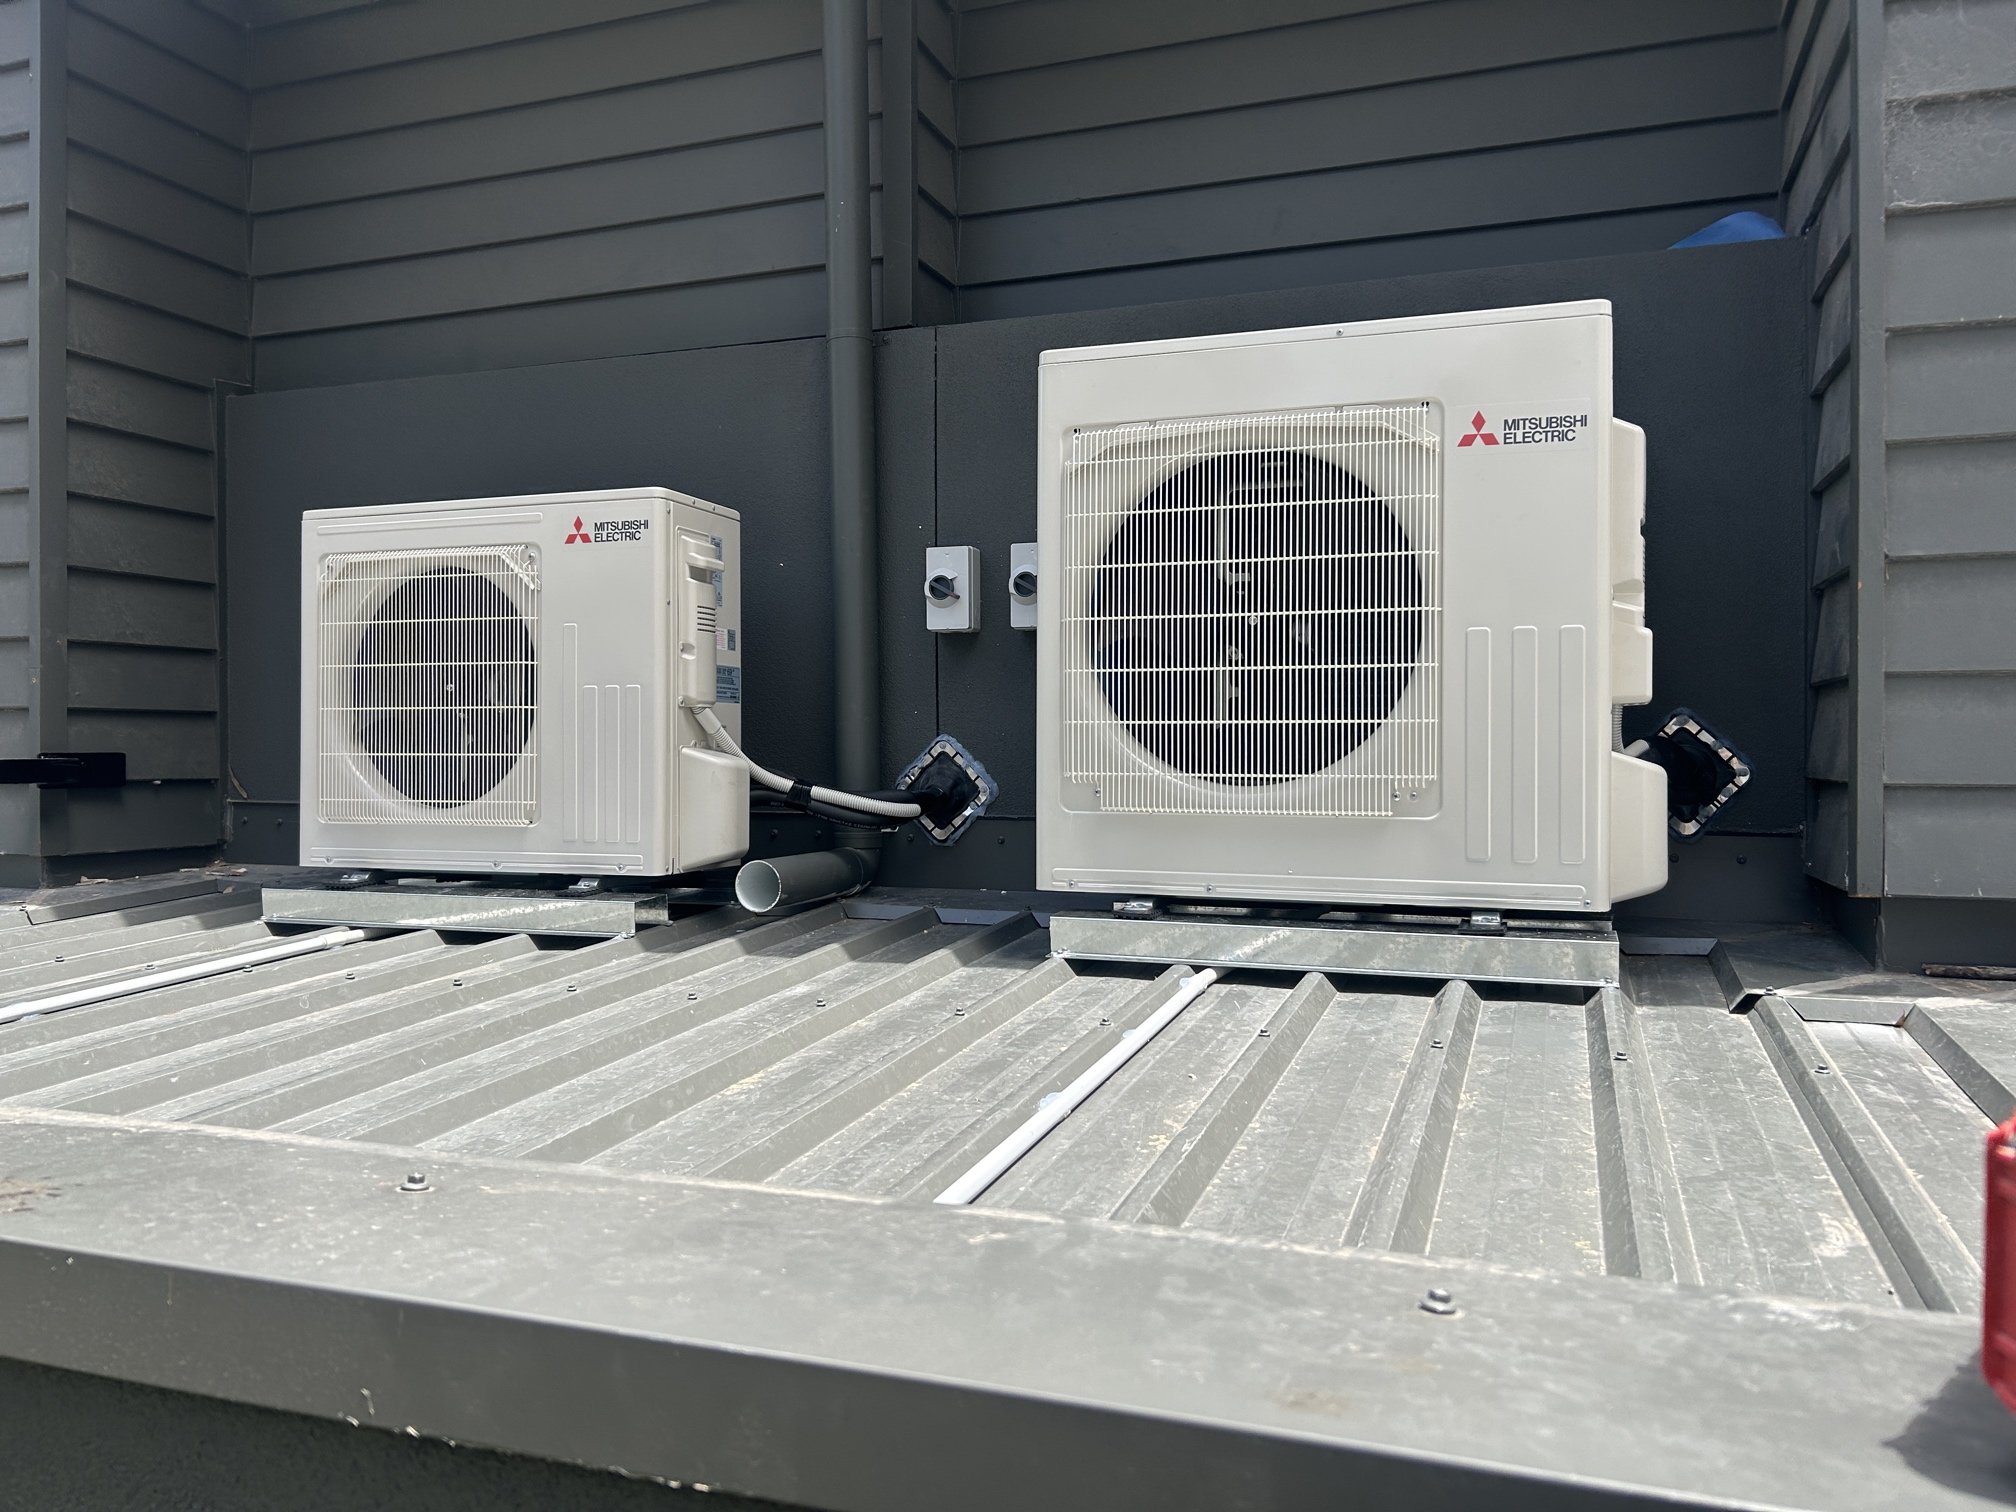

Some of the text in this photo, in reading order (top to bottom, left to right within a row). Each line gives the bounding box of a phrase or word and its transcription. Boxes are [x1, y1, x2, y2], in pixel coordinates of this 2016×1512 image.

[1503, 415, 1588, 431] MITSUBISHI
[1503, 429, 1577, 445] ELECTRIC
[594, 519, 649, 532] MITSUBISHI
[594, 530, 642, 543] ELECTRIC
